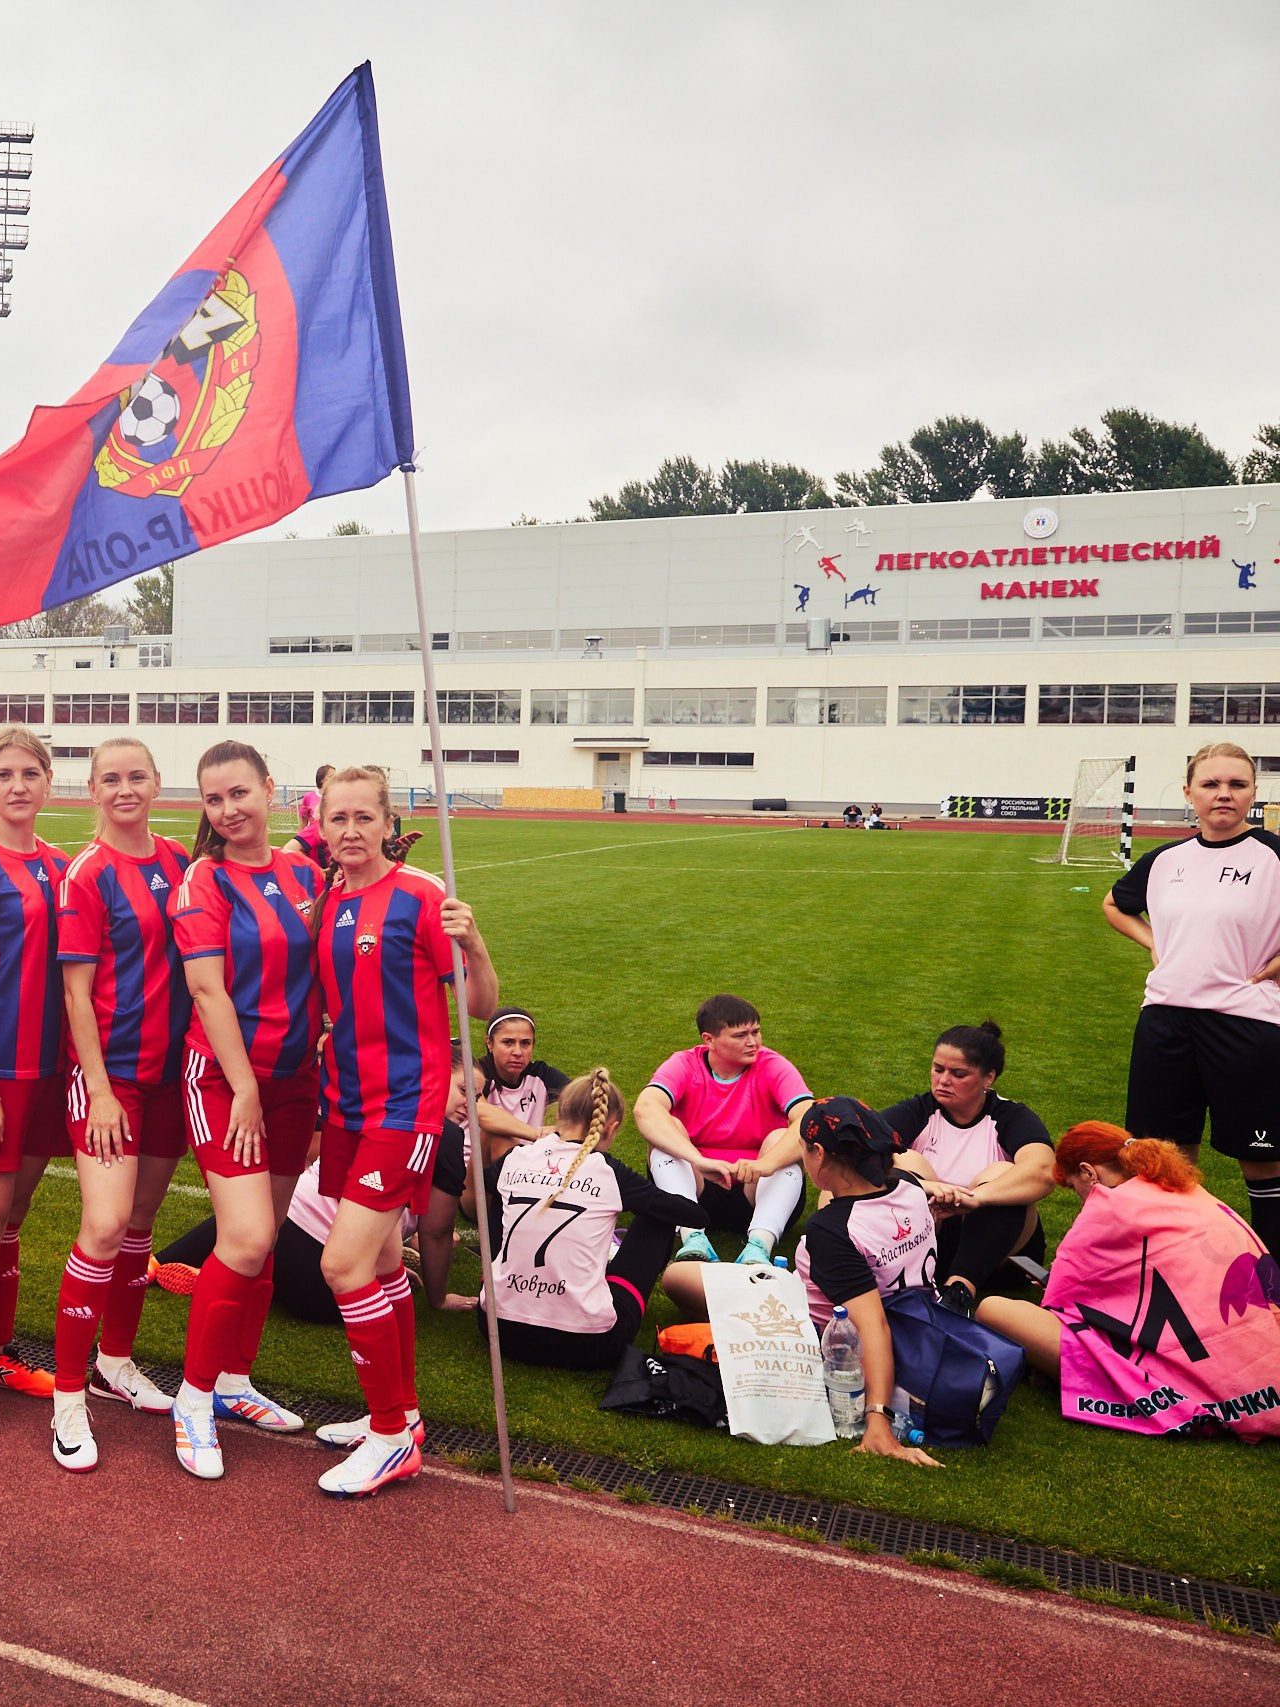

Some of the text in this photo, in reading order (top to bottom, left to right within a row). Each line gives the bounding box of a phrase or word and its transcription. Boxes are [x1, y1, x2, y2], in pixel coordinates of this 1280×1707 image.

[875, 535, 1221, 571] ЛЕГКОАТЛЕТИЧЕСКИЙ
[980, 578, 1100, 600] МАНЕЖ
[1218, 866, 1254, 885] FM
[501, 1191, 587, 1268] 77
[506, 1273, 567, 1298] Ковров
[729, 1340, 790, 1354] ROYAL
[754, 1360, 813, 1375] МАСЛА
